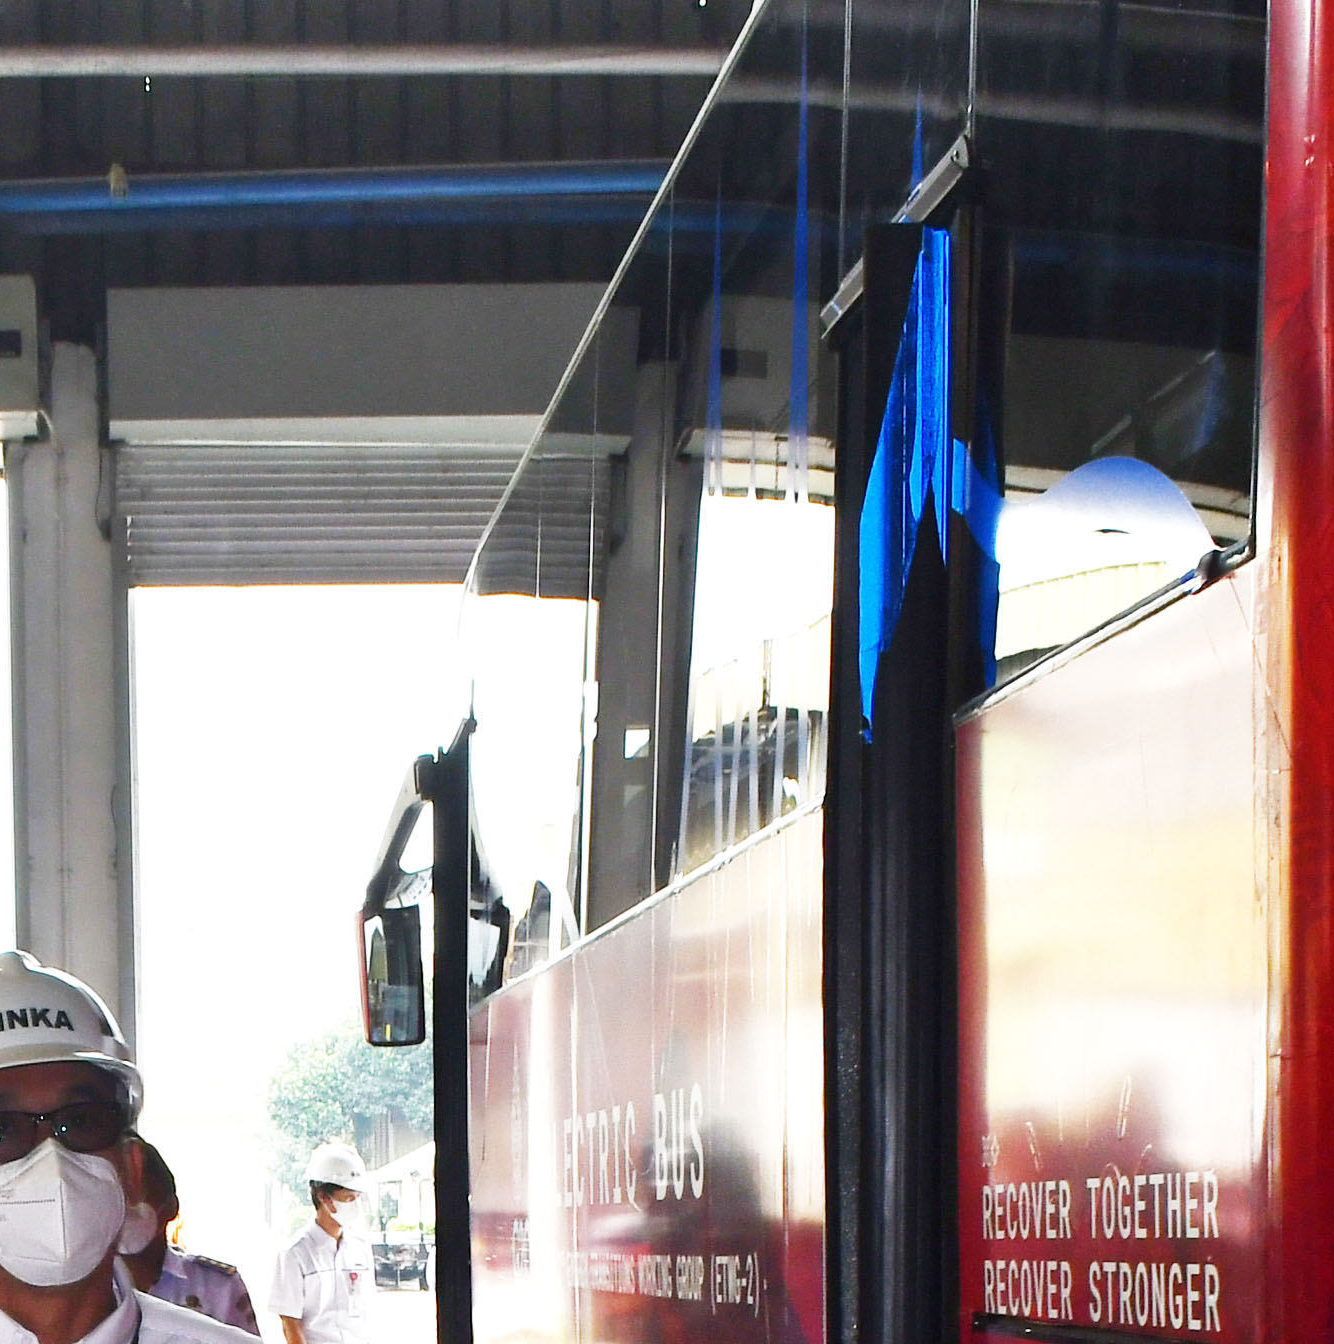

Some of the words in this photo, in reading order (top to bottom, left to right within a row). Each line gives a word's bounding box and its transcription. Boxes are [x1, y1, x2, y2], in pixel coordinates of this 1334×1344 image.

[552, 1101, 638, 1208] LECTRIC
[655, 1082, 703, 1201] BUS
[982, 1180, 1071, 1240] RECOVER
[1086, 1172, 1219, 1239] TOGETHER
[984, 1260, 1073, 1320] RECOVER
[1089, 1261, 1221, 1332] STRONGER
